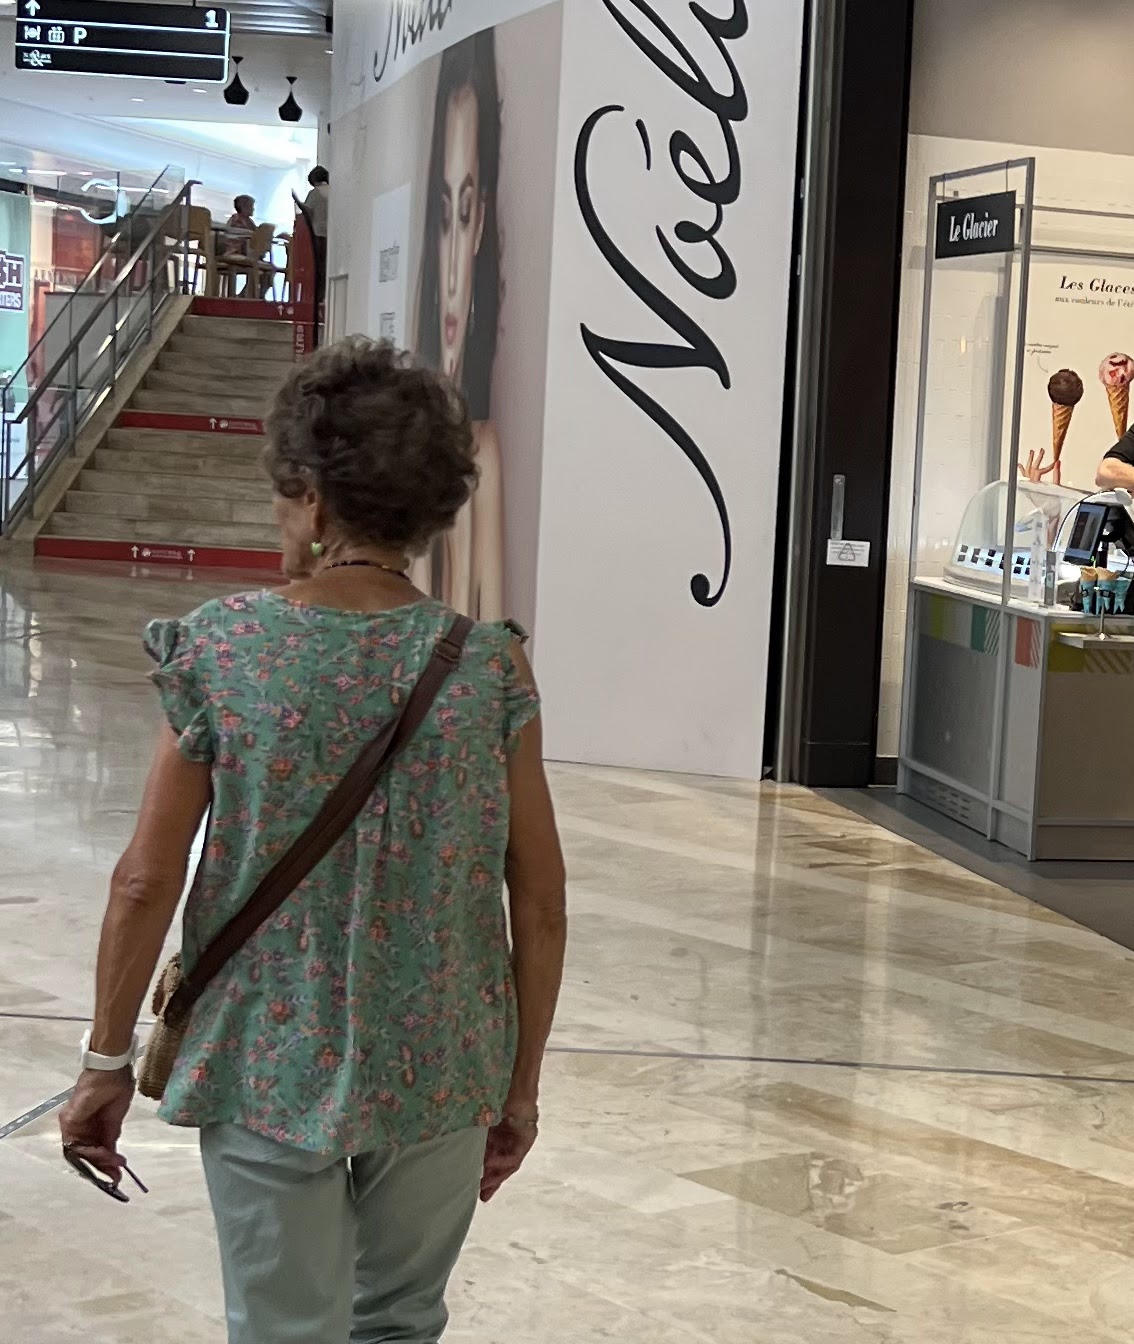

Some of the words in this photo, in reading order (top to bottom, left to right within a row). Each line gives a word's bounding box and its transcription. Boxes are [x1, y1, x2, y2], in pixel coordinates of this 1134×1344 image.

[205, 9, 218, 28] 1
[73, 27, 87, 44] P
[949, 216, 960, 242] Le
[962, 211, 998, 241] Glacier
[1059, 275, 1084, 291] Les
